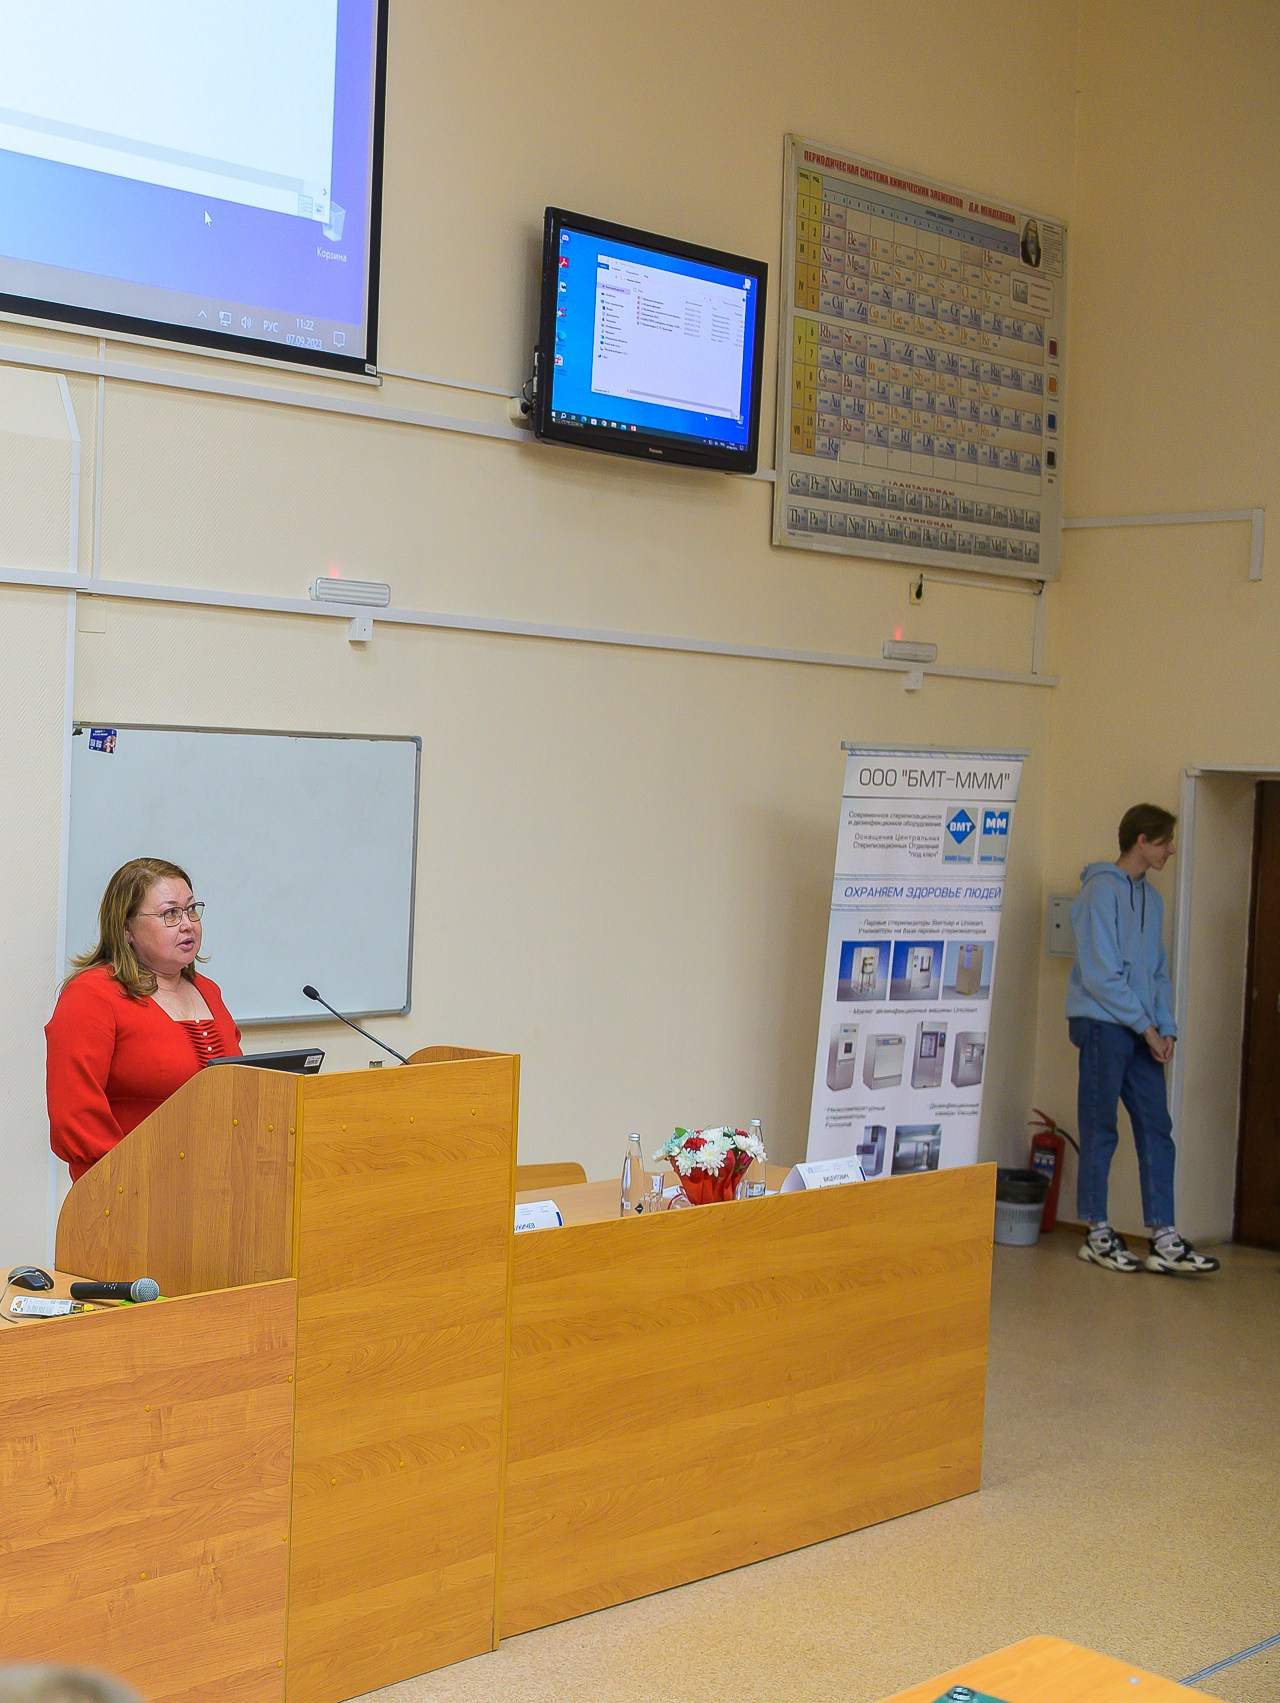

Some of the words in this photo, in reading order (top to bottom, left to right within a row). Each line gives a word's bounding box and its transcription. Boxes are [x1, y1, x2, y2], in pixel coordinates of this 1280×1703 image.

[804, 150, 860, 177] ПЕРИОДИЧЕСКАЯ
[860, 167, 889, 185] СИСТЕМА
[823, 225, 831, 240] Li
[317, 247, 347, 263] Корзина
[857, 301, 867, 316] Zn
[264, 321, 279, 333] РУС
[296, 318, 315, 331] 11:22
[286, 335, 323, 349] 07.09.2023
[855, 355, 866, 370] Cd
[854, 398, 865, 415] Hg
[859, 768, 898, 787] ООО
[902, 769, 1011, 790] "БМТ-МММ"
[848, 811, 889, 819] Современное
[986, 817, 1007, 829] MM
[844, 886, 904, 899] ОХРАНЯЕМ
[906, 887, 962, 900] ЗДОРОВЬЕ
[964, 886, 1002, 900] ЛЮДЕЙ
